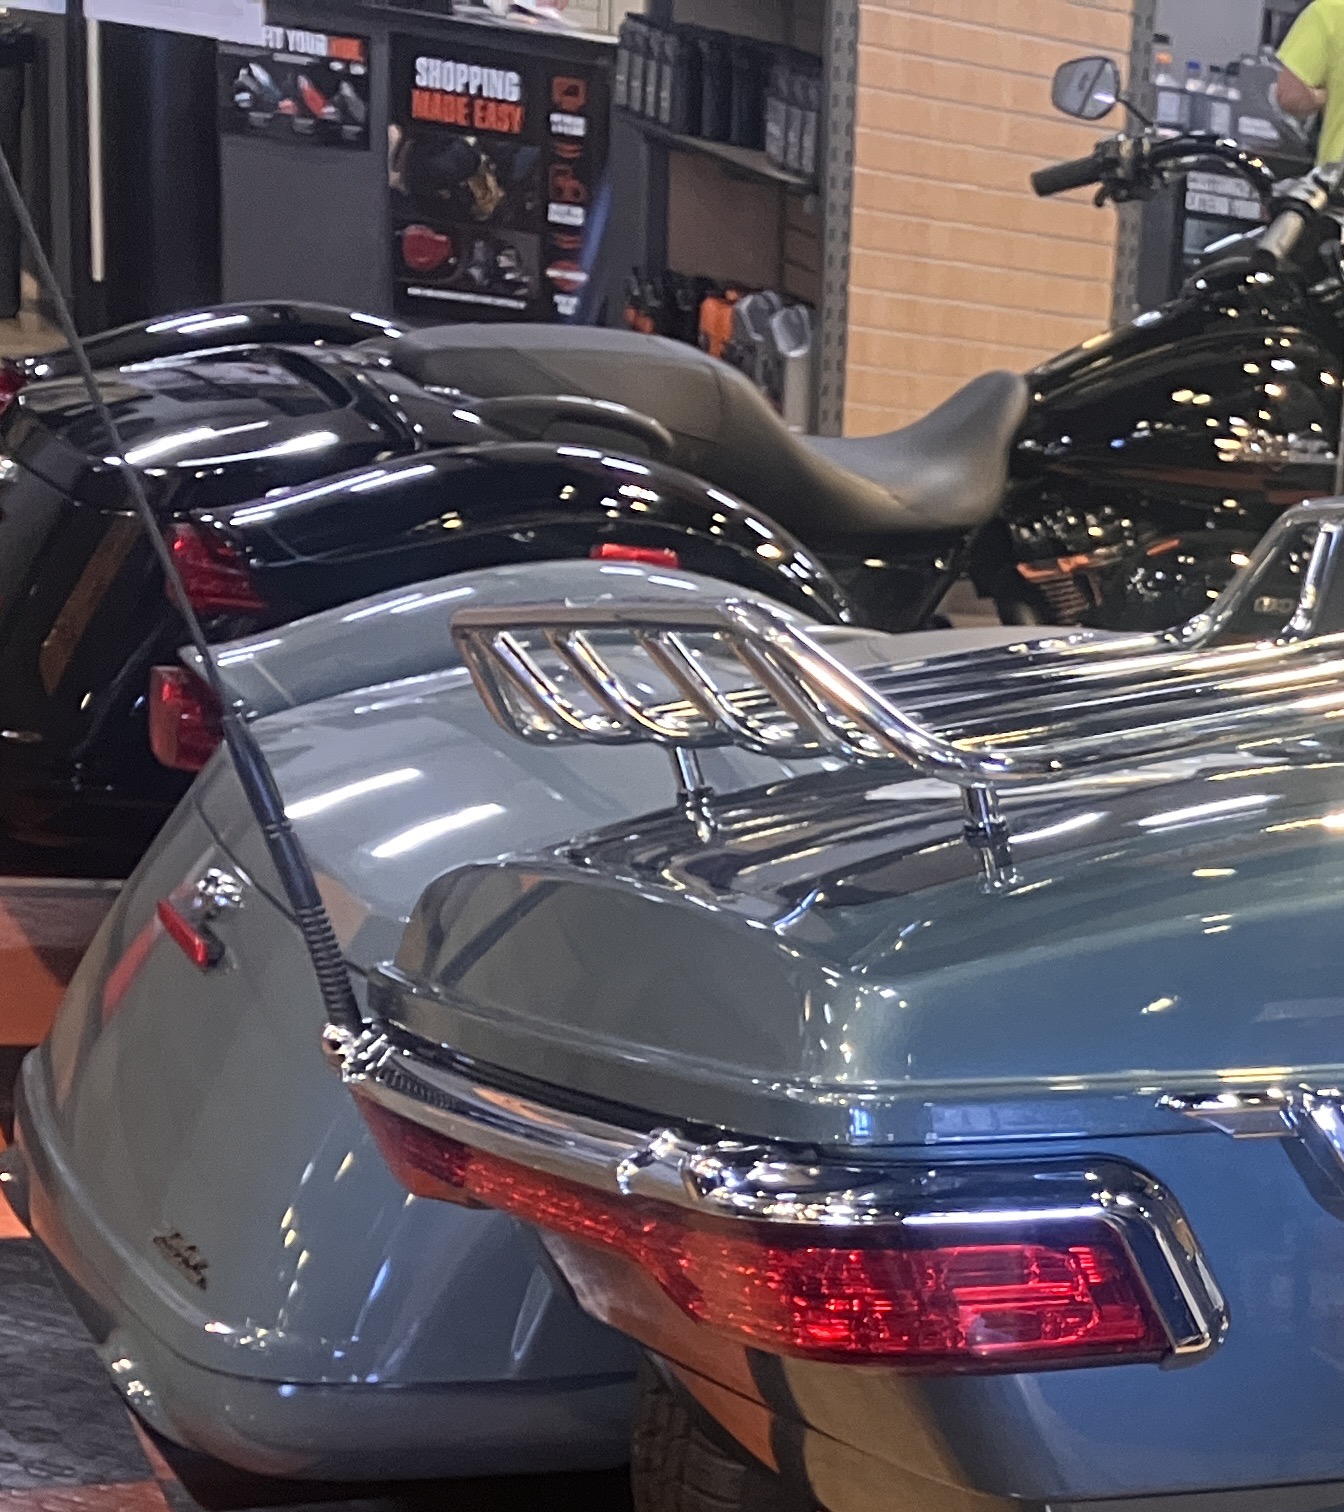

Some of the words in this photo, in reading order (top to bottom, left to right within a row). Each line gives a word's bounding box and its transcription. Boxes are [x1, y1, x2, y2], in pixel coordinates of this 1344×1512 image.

[286, 29, 327, 57] YOUR
[415, 56, 521, 102] SHOPPING
[411, 87, 469, 126] MADE
[475, 98, 525, 135] EASY
